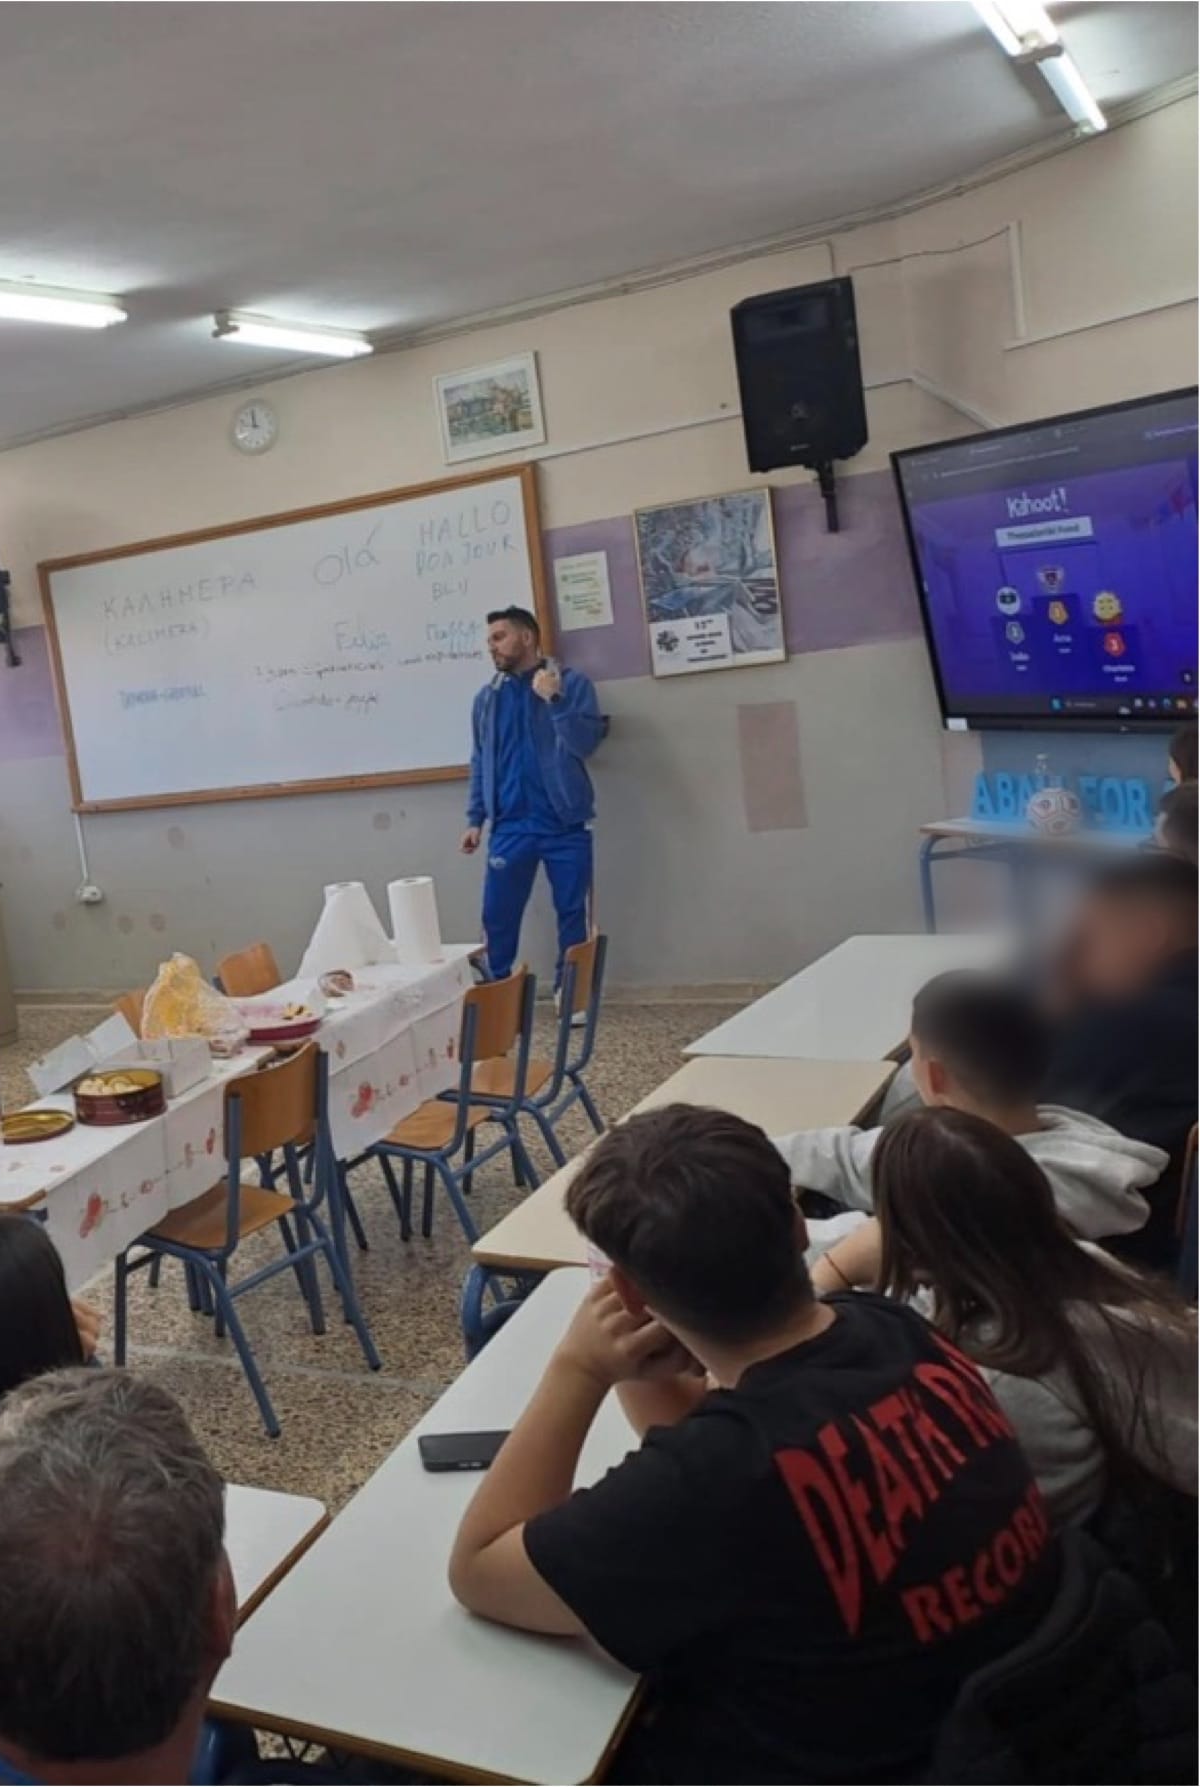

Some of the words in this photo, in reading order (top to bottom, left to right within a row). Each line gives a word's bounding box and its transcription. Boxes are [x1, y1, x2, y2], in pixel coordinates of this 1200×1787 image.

[419, 499, 511, 546] HALLO
[1007, 487, 1068, 518] Kahoot!
[313, 520, 383, 586] Olá
[773, 1386, 968, 1636] DEATH
